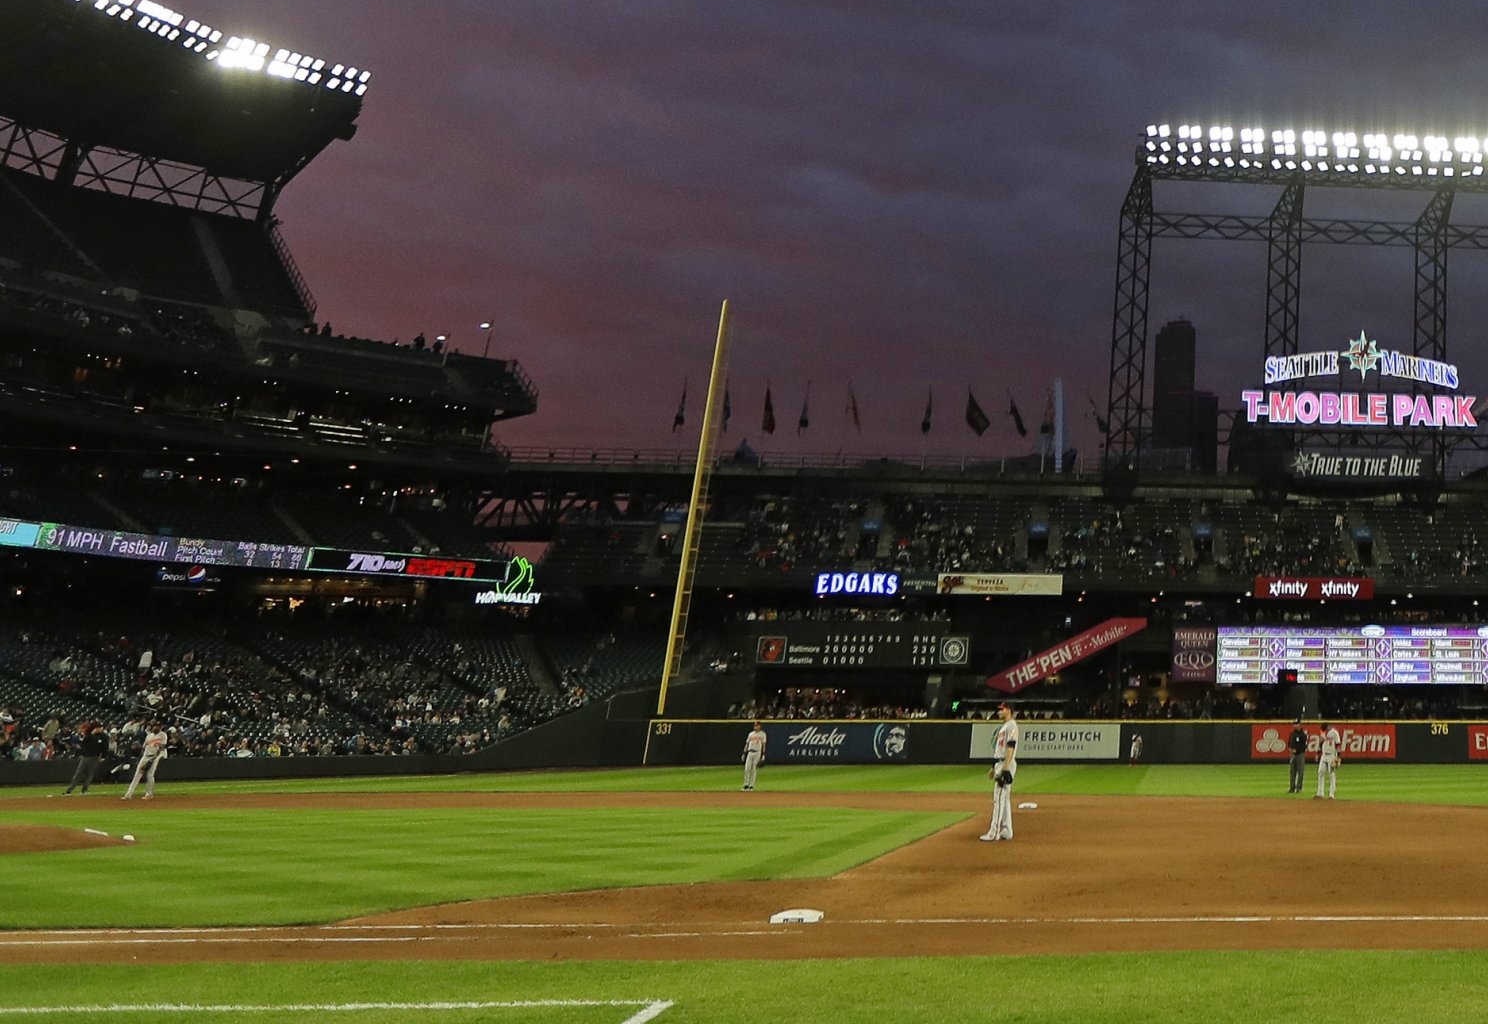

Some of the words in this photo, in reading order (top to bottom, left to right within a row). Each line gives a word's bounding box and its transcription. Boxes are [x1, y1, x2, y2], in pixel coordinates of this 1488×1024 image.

[1264, 352, 1339, 384] SEATTLE
[1381, 349, 1458, 388] MARINERS
[1242, 390, 1388, 424] T-MOBILE
[1393, 394, 1477, 426] PARK
[1310, 454, 1341, 476] TRUE
[1345, 457, 1360, 475] TO
[1363, 457, 1386, 476] THE
[1388, 455, 1422, 476] BLUE
[47, 529, 65, 546] 91
[66, 531, 104, 549] MPH
[110, 536, 168, 556] Fastball
[347, 554, 384, 571] 710
[406, 558, 476, 578] ESPN
[162, 573, 186, 582] pepsi
[1269, 581, 1308, 598] xfinity
[1320, 581, 1360, 598] xfinity
[1092, 628, 1124, 648] Mobile
[1175, 632, 1215, 641] EMERALD
[1180, 640, 1208, 648] QUEEN
[788, 656, 813, 664] Seattle
[1005, 664, 1039, 688] THE
[656, 724, 672, 735] 331
[788, 726, 847, 746] Alaska
[1024, 732, 1056, 742] FRED
[1061, 732, 1101, 742] HUTCH
[1431, 723, 1448, 735] 376
[1340, 730, 1390, 752] Farm
[789, 748, 839, 756] AIRLINES
